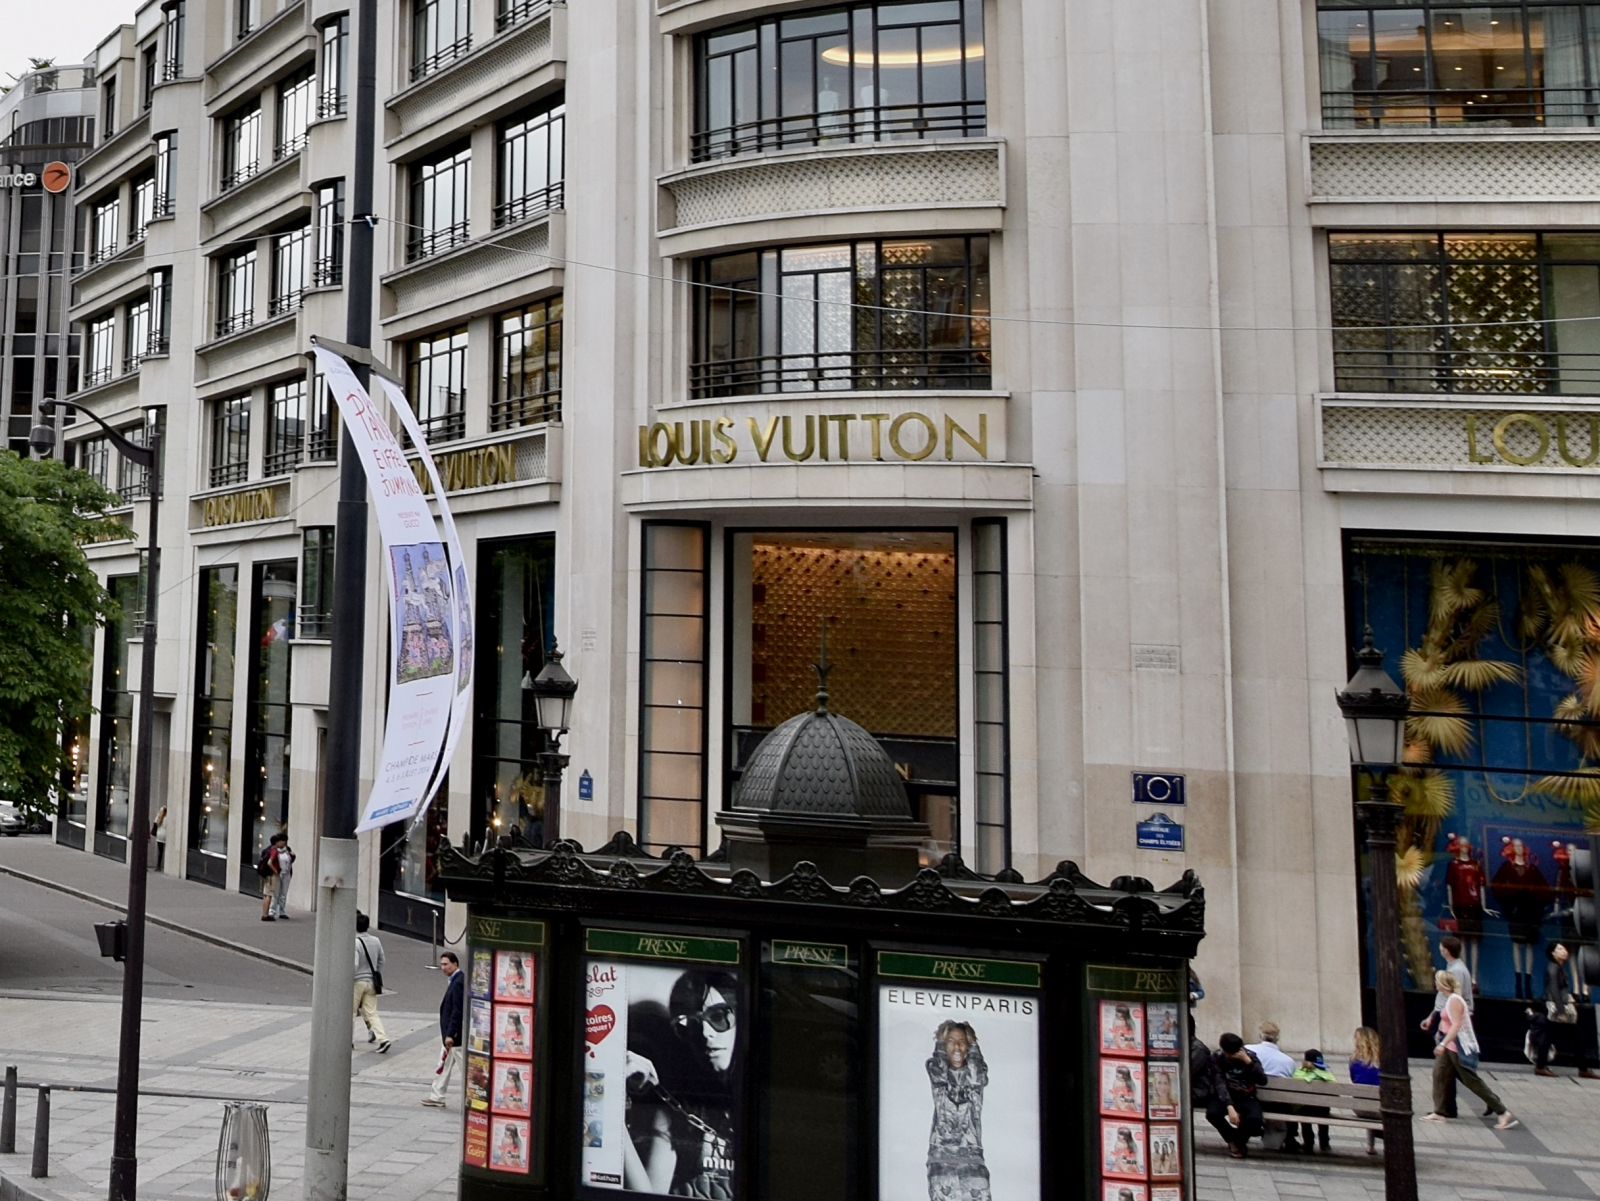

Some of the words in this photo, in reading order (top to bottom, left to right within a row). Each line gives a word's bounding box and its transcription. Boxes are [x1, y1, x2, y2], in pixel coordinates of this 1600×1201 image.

[638, 416, 738, 468] LOUIS
[745, 411, 988, 462] VUITTON
[444, 443, 517, 491] VUITTON
[230, 487, 276, 524] VUITTON
[1135, 775, 1181, 802] 101
[637, 937, 689, 956] PRESSE
[784, 945, 837, 963] PRESSE
[932, 960, 987, 979] PRESSE
[888, 989, 1033, 1015] ELEVENPARIS
[594, 1173, 620, 1183] Nathan
